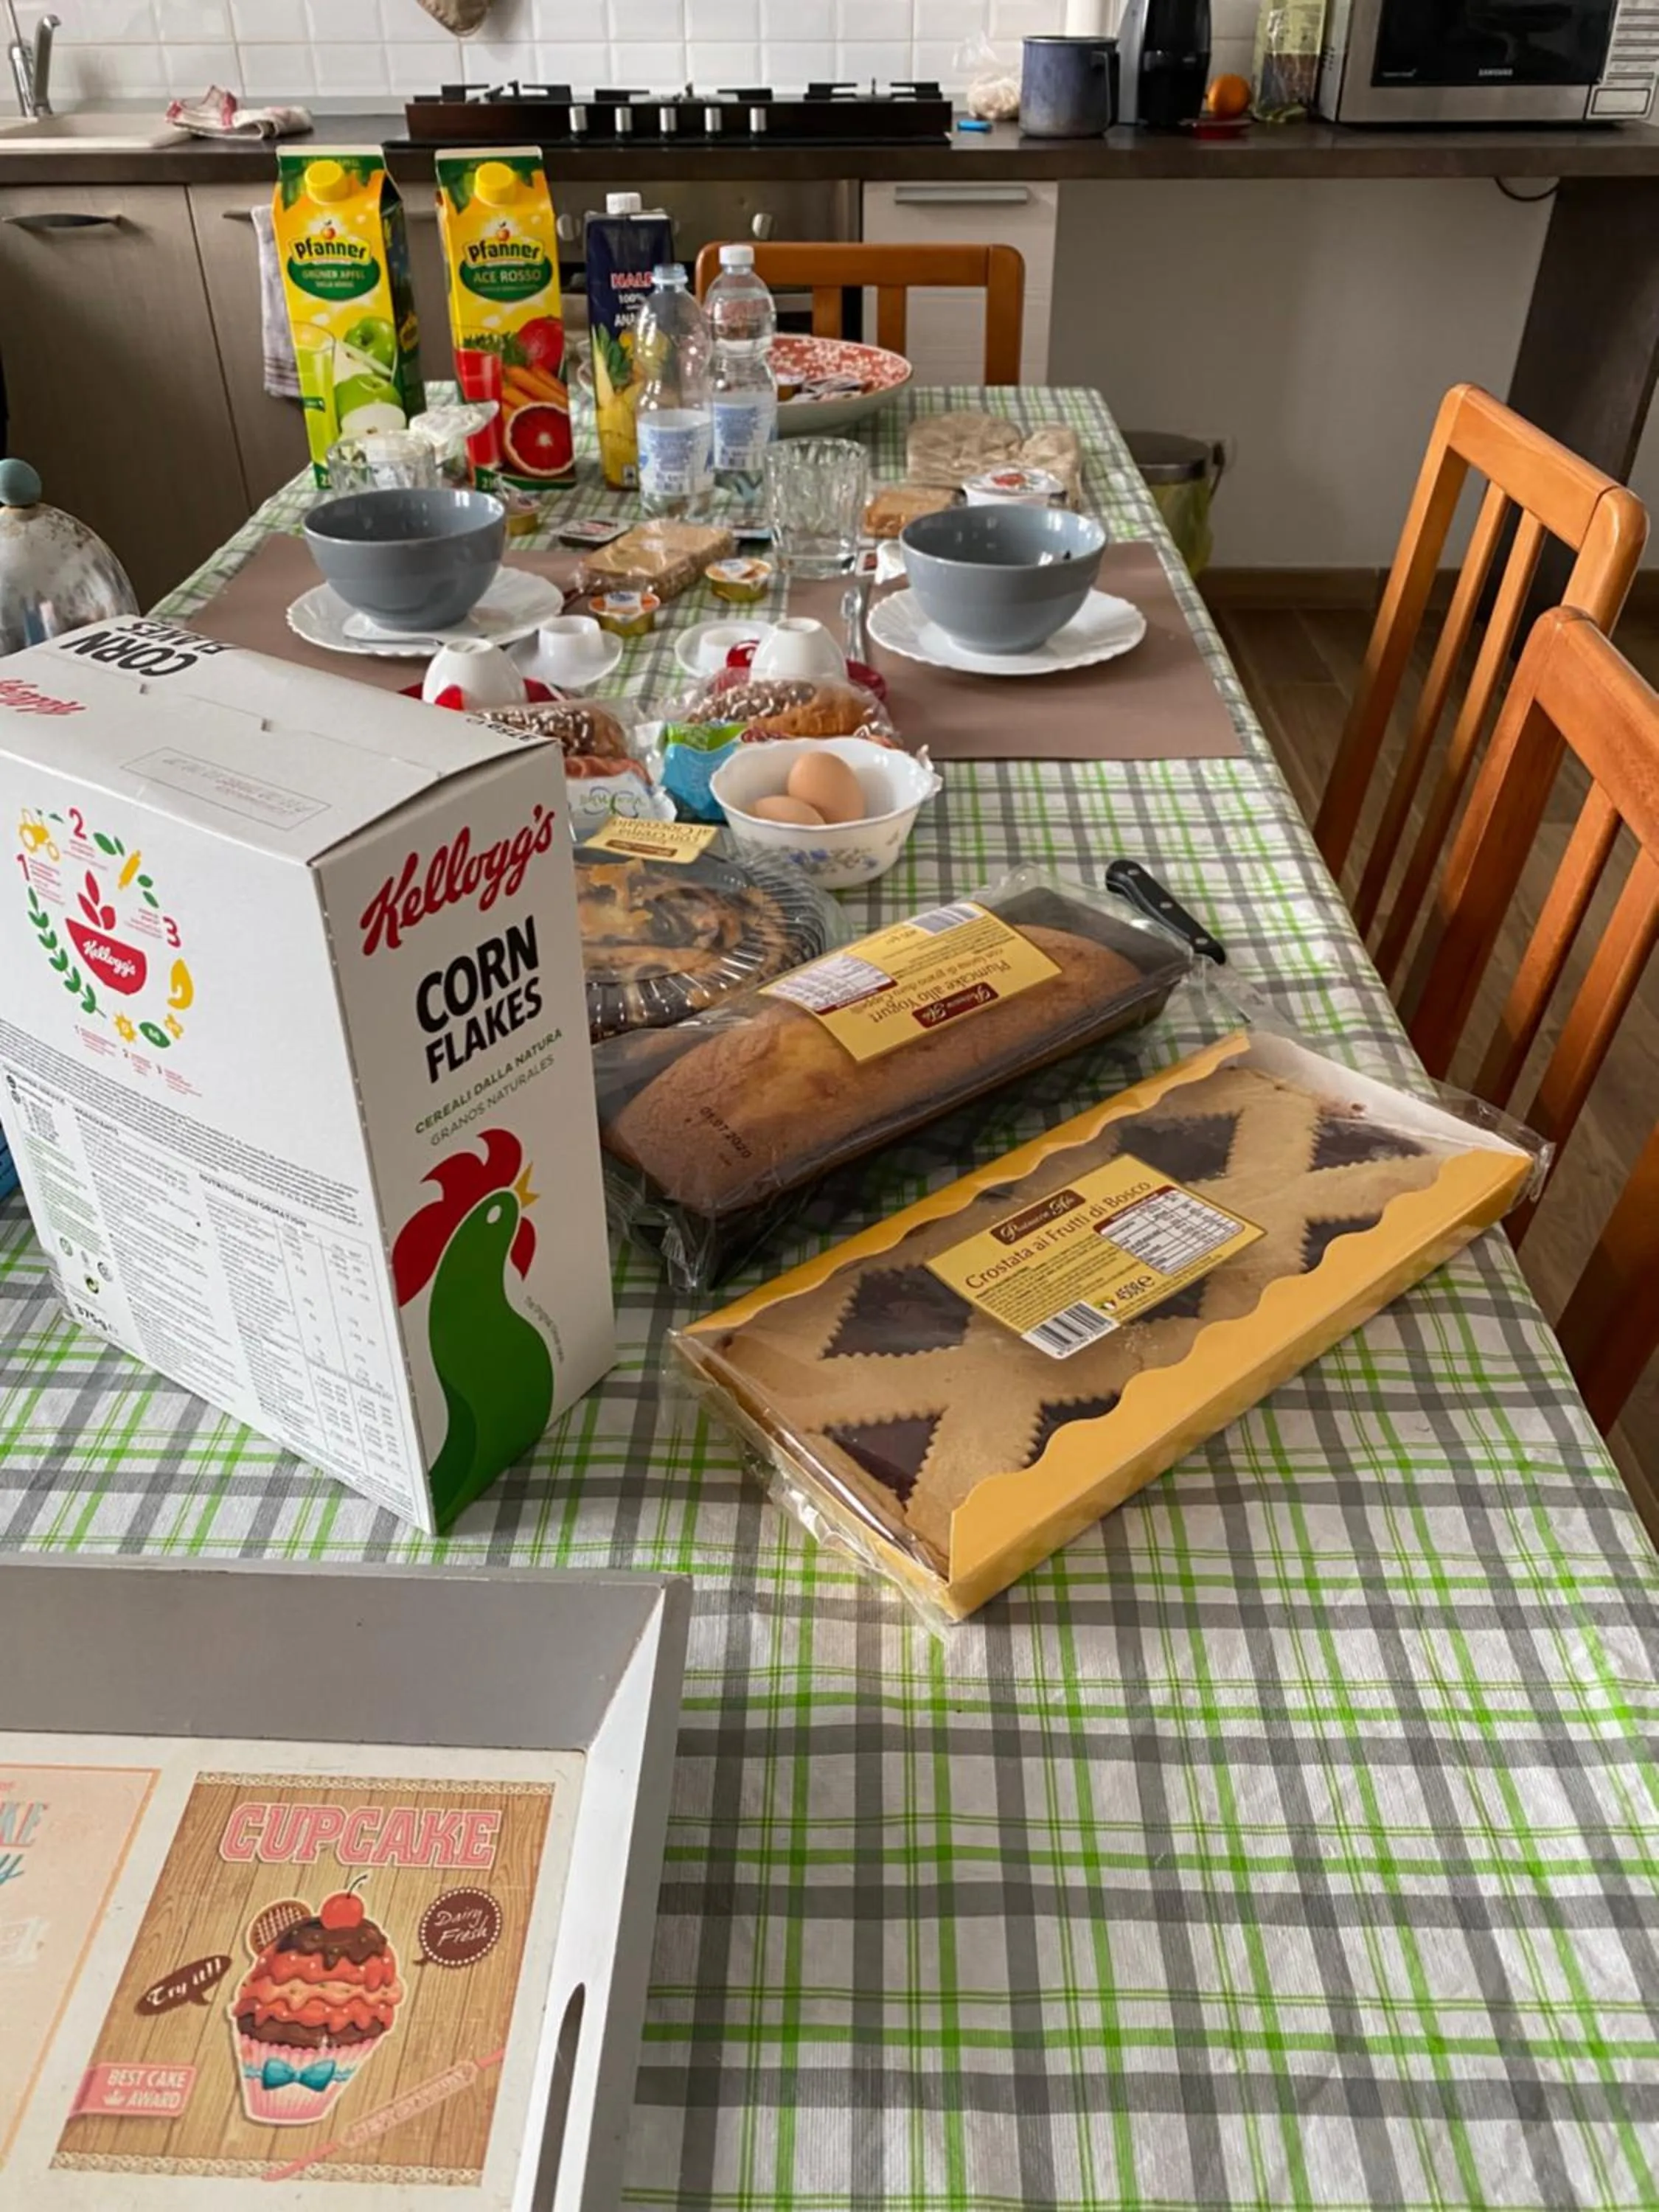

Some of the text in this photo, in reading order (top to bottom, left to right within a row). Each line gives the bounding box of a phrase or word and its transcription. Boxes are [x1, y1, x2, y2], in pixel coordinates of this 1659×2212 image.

[293, 237, 366, 260] Pfanner
[467, 239, 540, 263] Pfanner
[473, 268, 541, 283] ACE ROSSO
[59, 631, 198, 677] CORN
[69, 808, 87, 840] 2
[17, 854, 30, 881] 1
[360, 804, 555, 956] Kellogg's
[162, 916, 181, 947] 3
[83, 939, 136, 978] Kellogg's
[416, 914, 540, 1033] CORN
[947, 959, 1012, 990] Plumcake
[918, 984, 945, 1002] allo
[869, 996, 920, 1023] Yogurt
[425, 976, 543, 1085] FLAKES
[414, 1028, 563, 1134] CEREALI DALLA NATURA
[430, 1054, 555, 1147] GRANOS NATURALES
[964, 1247, 1034, 1291] Crostata
[1035, 1235, 1050, 1251] ai
[1045, 1212, 1089, 1242] Frutti
[1089, 1203, 1107, 1219] di
[1102, 1180, 1152, 1210] Bosco
[219, 1801, 502, 1870] CUPCAKE
[434, 1906, 483, 1930] Dairy
[439, 1921, 490, 1948] Fresh
[146, 1983, 187, 2006] Try
[107, 2069, 188, 2088] BEST CAKE
[126, 2090, 182, 2109] AWARD
